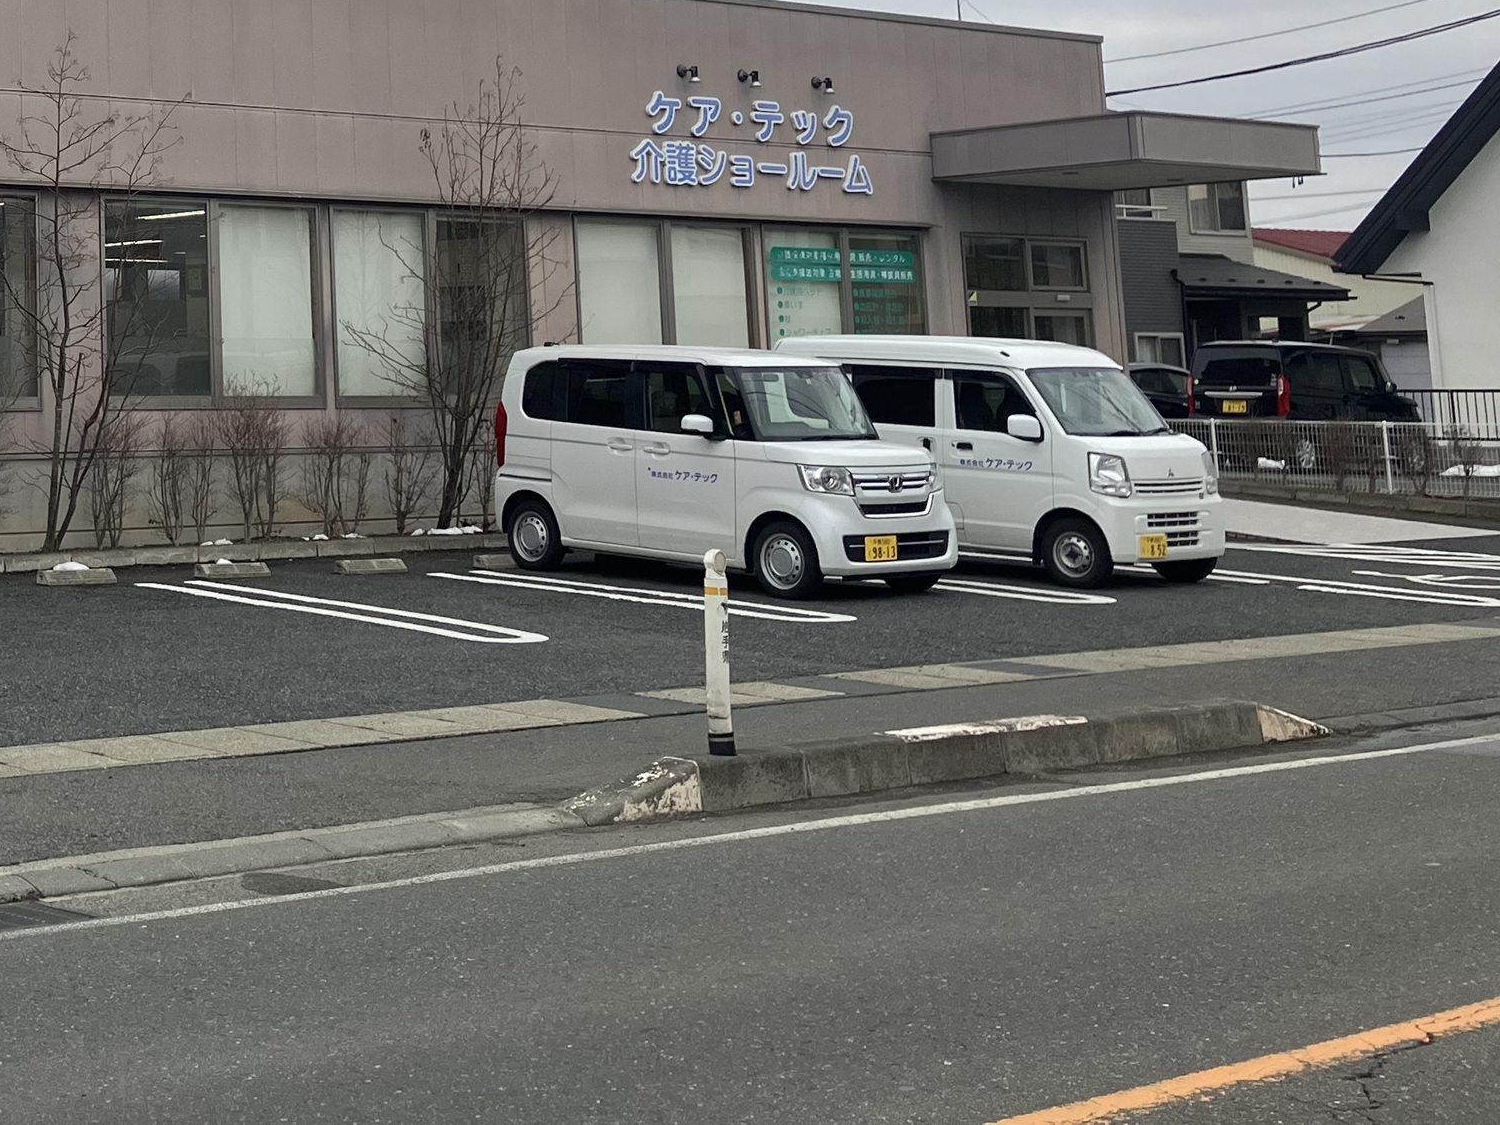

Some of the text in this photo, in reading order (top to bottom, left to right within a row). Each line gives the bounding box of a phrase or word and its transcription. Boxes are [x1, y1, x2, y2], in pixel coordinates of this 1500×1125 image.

[646, 91, 853, 147] ケア・テック
[630, 139, 874, 195] 介護ショールーム
[872, 545, 896, 559] 98-13
